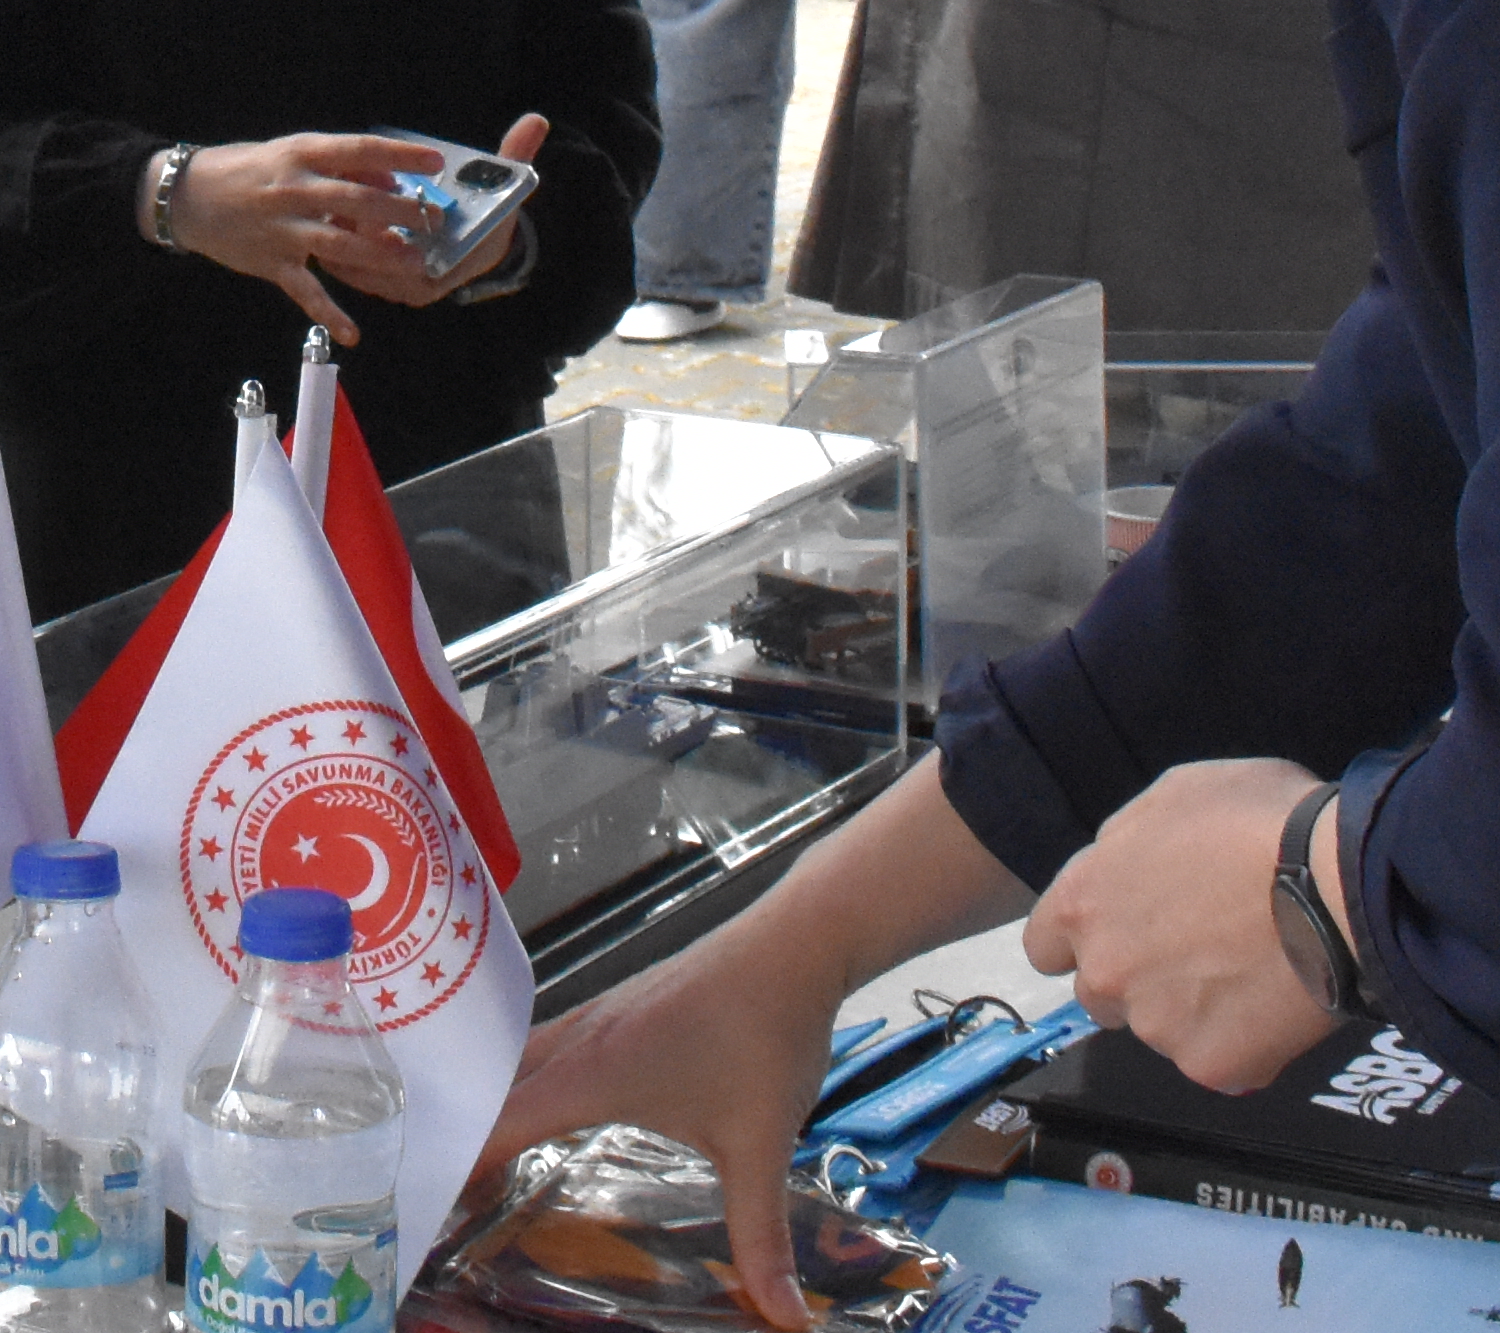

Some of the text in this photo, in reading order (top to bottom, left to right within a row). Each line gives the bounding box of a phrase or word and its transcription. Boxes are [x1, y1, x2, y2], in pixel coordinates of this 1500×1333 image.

[281, 762, 386, 794] SAVUNMA
[244, 789, 283, 842] MİLLİ
[388, 779, 448, 887] BAKANLIĞI
[348, 932, 422, 976] TÜRKİY
[198, 1273, 338, 1328] damla
